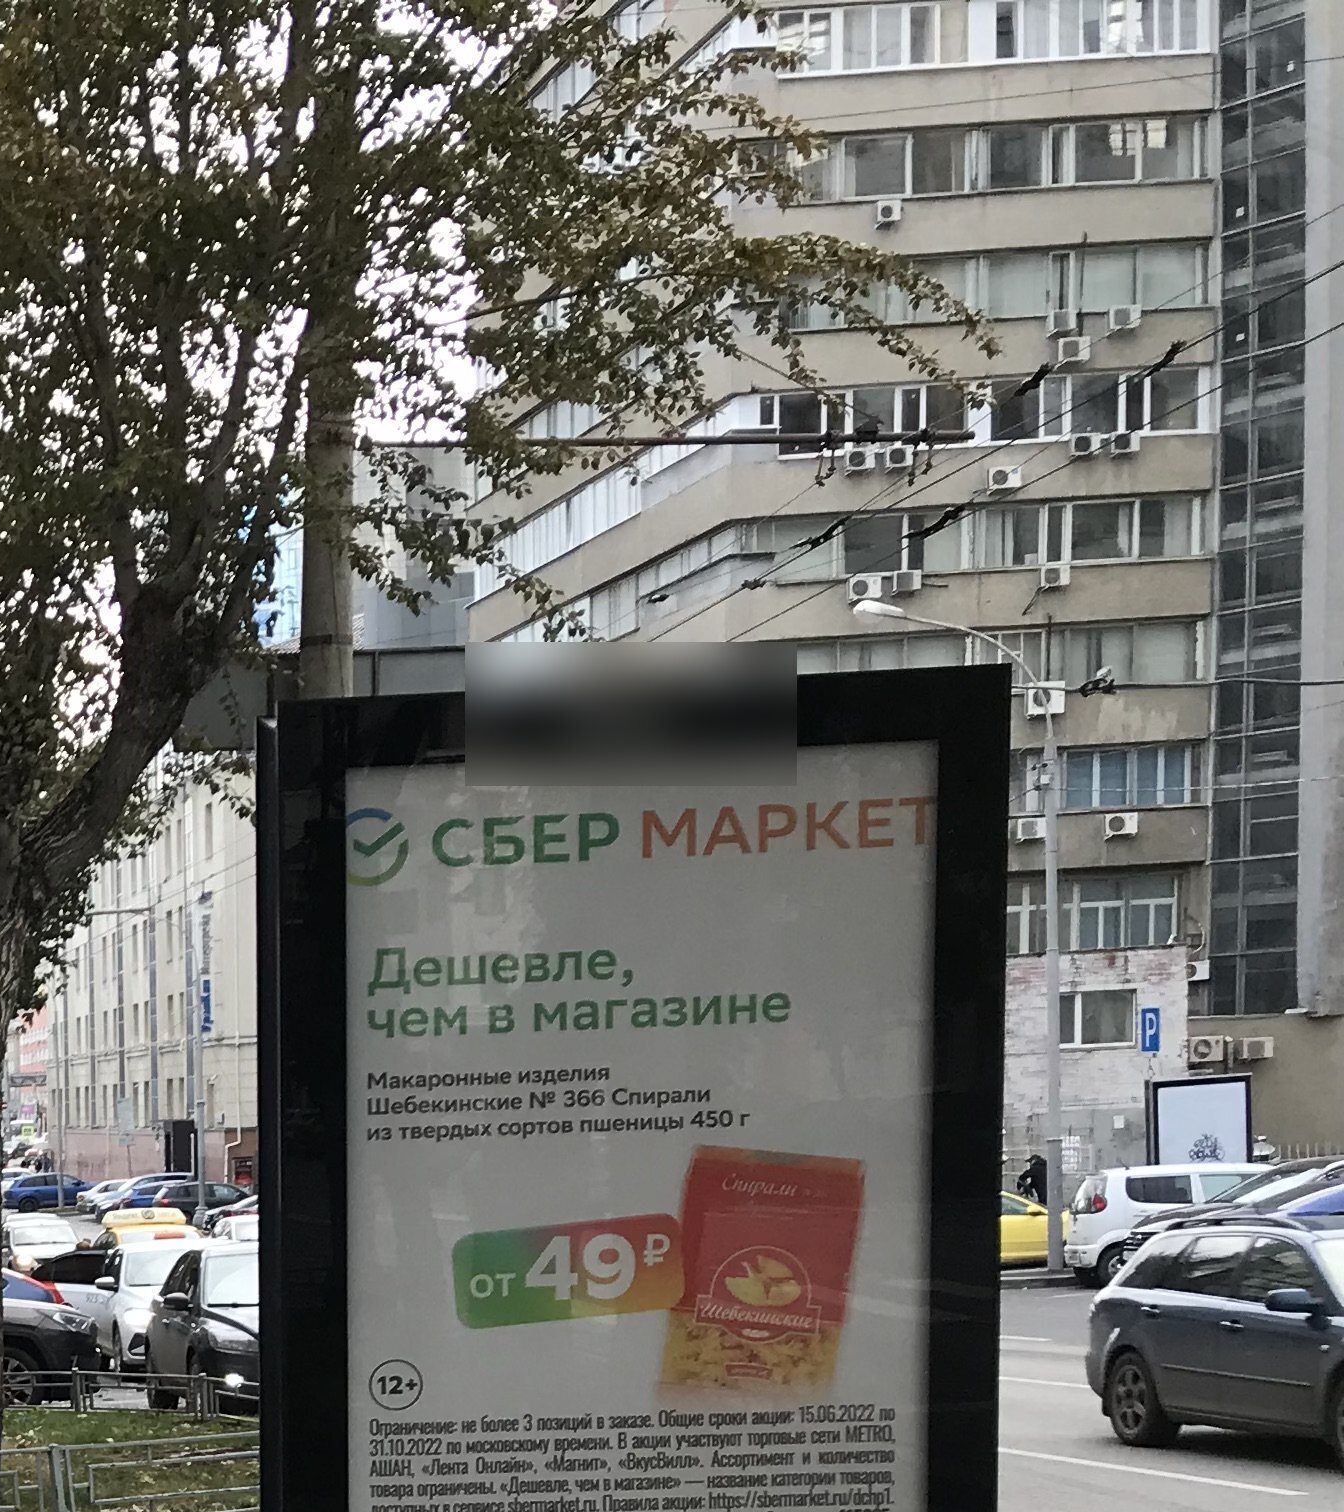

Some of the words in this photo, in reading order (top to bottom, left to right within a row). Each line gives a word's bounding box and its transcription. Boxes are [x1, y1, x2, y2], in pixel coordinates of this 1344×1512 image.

[431, 812, 621, 868] СБЕР
[641, 796, 937, 859] МАРКЕТ
[368, 946, 636, 996] Дешевле,
[367, 1005, 468, 1040] чем
[486, 1004, 516, 1034] в
[533, 990, 792, 1034] магазине
[1144, 1012, 1157, 1048] P
[367, 1066, 513, 1092] Макаронные
[518, 1062, 611, 1086] изделия
[367, 1091, 523, 1116] Шебекинские
[528, 1090, 556, 1111] №
[563, 1089, 606, 1109] 366
[612, 1082, 711, 1109] Спирали
[367, 1124, 393, 1142] из
[398, 1119, 492, 1144] твердых
[498, 1115, 573, 1141] сортов
[580, 1111, 684, 1135] пшеницы
[691, 1109, 733, 1130] 450
[738, 1111, 751, 1129] г
[722, 1172, 798, 1199] Спирали
[470, 1272, 516, 1300] от
[700, 1300, 813, 1330] Шебекинские
[377, 1374, 418, 1395] 12+
[369, 1418, 458, 1438] Ограничение:
[462, 1420, 477, 1433] не
[481, 1415, 520, 1432] более
[523, 1415, 533, 1431] 3
[537, 1412, 593, 1432] позиций
[597, 1416, 604, 1429] в
[609, 1415, 654, 1429] заказе.
[658, 1409, 704, 1429] Общие
[709, 1410, 747, 1429] сроки
[752, 1410, 795, 1426] акции:
[799, 1404, 874, 1423] 15.06.2022
[879, 1407, 895, 1421] по
[369, 1439, 442, 1457] 31.10.2022
[446, 1440, 461, 1454] по
[466, 1438, 550, 1456] московскому
[554, 1436, 613, 1455] времени.
[618, 1432, 628, 1449] В
[632, 1432, 671, 1449] акции
[675, 1431, 742, 1450] участвуют
[748, 1429, 806, 1448] торговые
[810, 1429, 840, 1444] сети
[845, 1425, 896, 1444] METRO,
[369, 1460, 415, 1478] АШАН,
[422, 1459, 469, 1477] «Лента
[476, 1457, 537, 1474] Онлайн»,
[544, 1454, 611, 1473] «Магнит»,
[618, 1451, 704, 1472] «ВкусВилл».
[711, 1451, 795, 1470] Ассортимент
[802, 1453, 810, 1465] и
[819, 1449, 895, 1465] количество
[369, 1484, 413, 1500] товара
[417, 1481, 496, 1499] ограничены.
[500, 1476, 572, 1496] «Дешевле,
[575, 1479, 599, 1492] чем
[604, 1479, 611, 1492] в
[614, 1476, 681, 1490] магазине»
[707, 1474, 767, 1489] название
[771, 1471, 835, 1489] категории
[840, 1471, 895, 1489] товаров,
[662, 1495, 706, 1512] акции:
